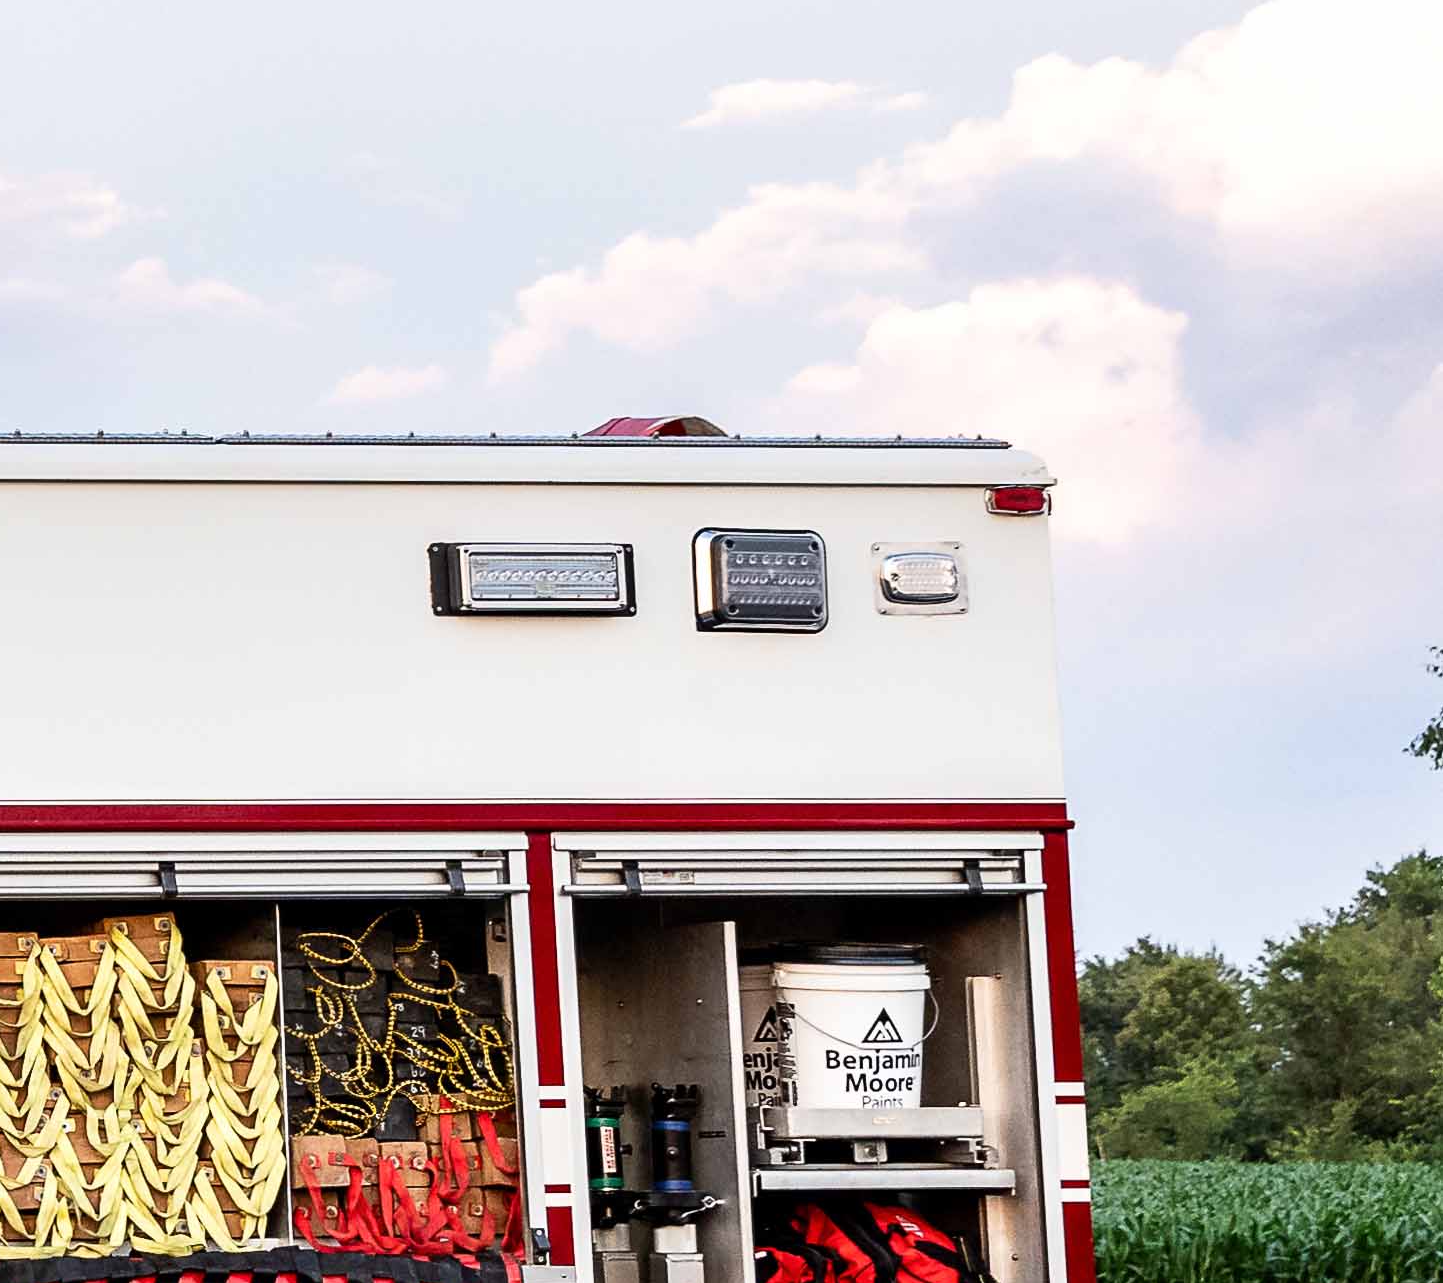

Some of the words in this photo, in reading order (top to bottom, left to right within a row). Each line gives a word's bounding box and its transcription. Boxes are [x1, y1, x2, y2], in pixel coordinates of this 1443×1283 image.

[410, 1026, 426, 1038] 29
[825, 1049, 920, 1075] Benjamin
[846, 1073, 913, 1093] Moore
[862, 1095, 903, 1109] Paints
